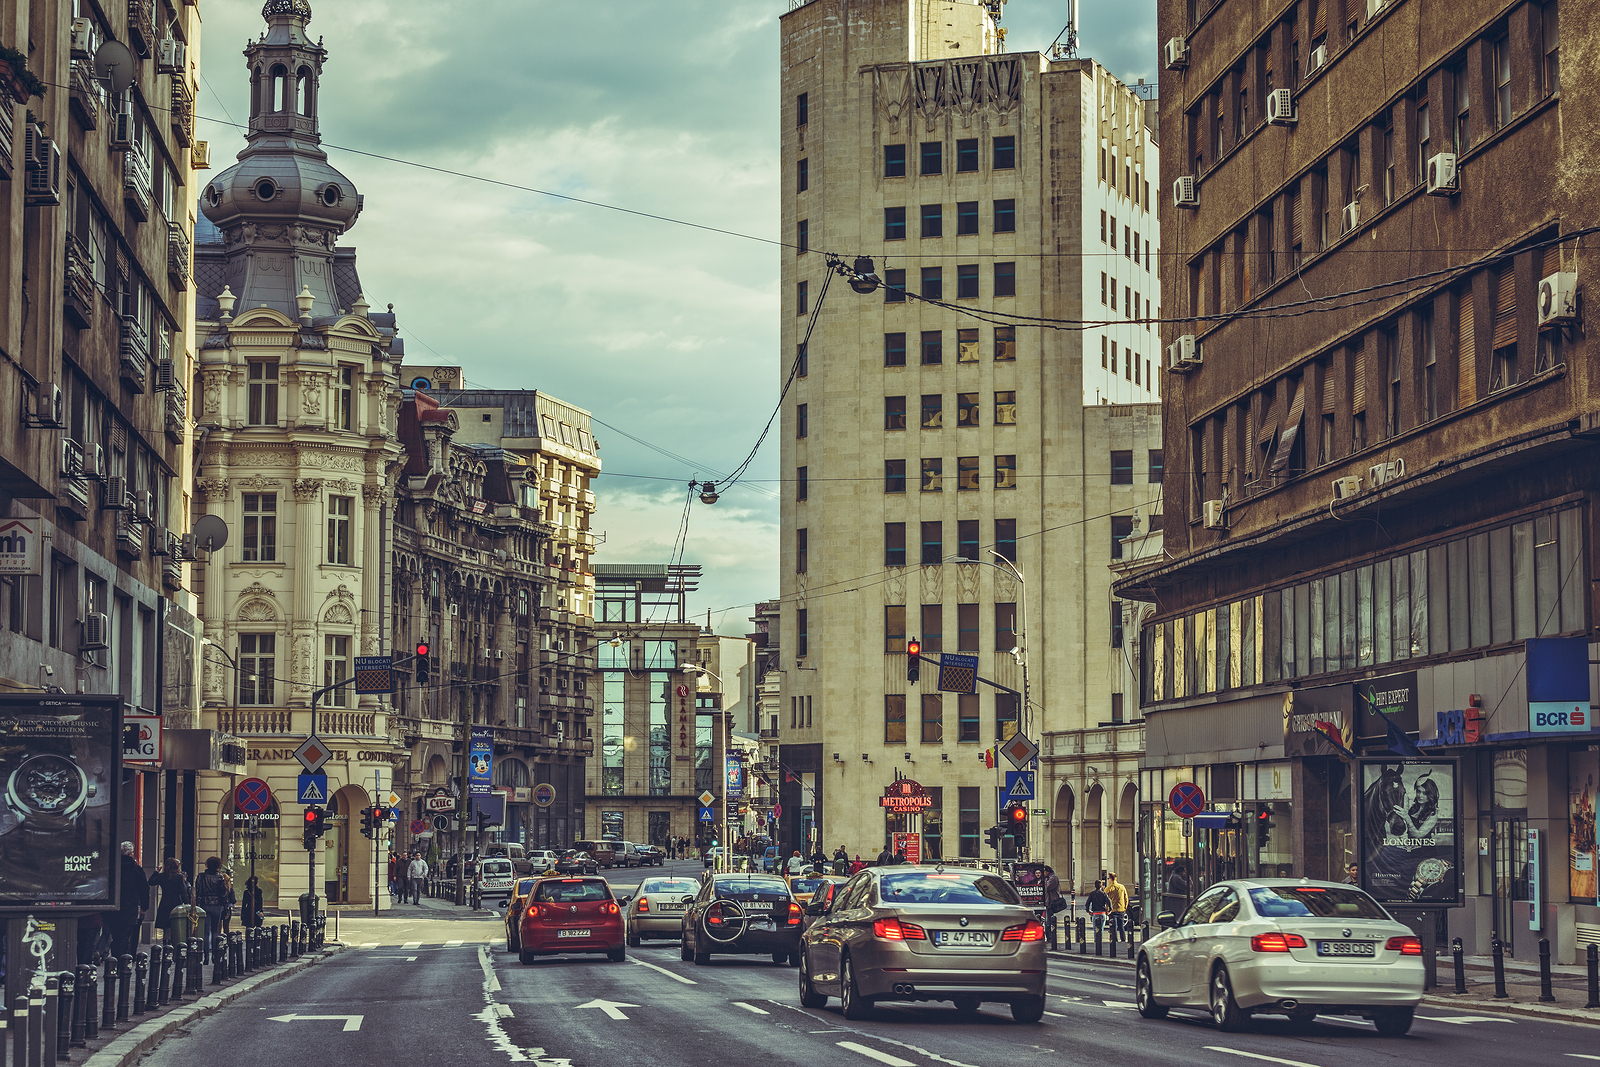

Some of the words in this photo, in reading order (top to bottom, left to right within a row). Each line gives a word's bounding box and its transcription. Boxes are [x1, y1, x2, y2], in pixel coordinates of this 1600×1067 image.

[1376, 691, 1387, 706] HIFI
[1388, 687, 1410, 704] EXPERT
[679, 698, 687, 748] RAMADA
[1536, 712, 1569, 726] BCR
[1437, 709, 1465, 745] BCR
[246, 749, 295, 761] GRAND
[882, 796, 932, 806] METROPOLIS
[1382, 837, 1436, 847] LONGINES
[64, 863, 92, 872] BLANC
[941, 932, 949, 942] B
[954, 932, 965, 942] 47
[1323, 942, 1331, 953] B
